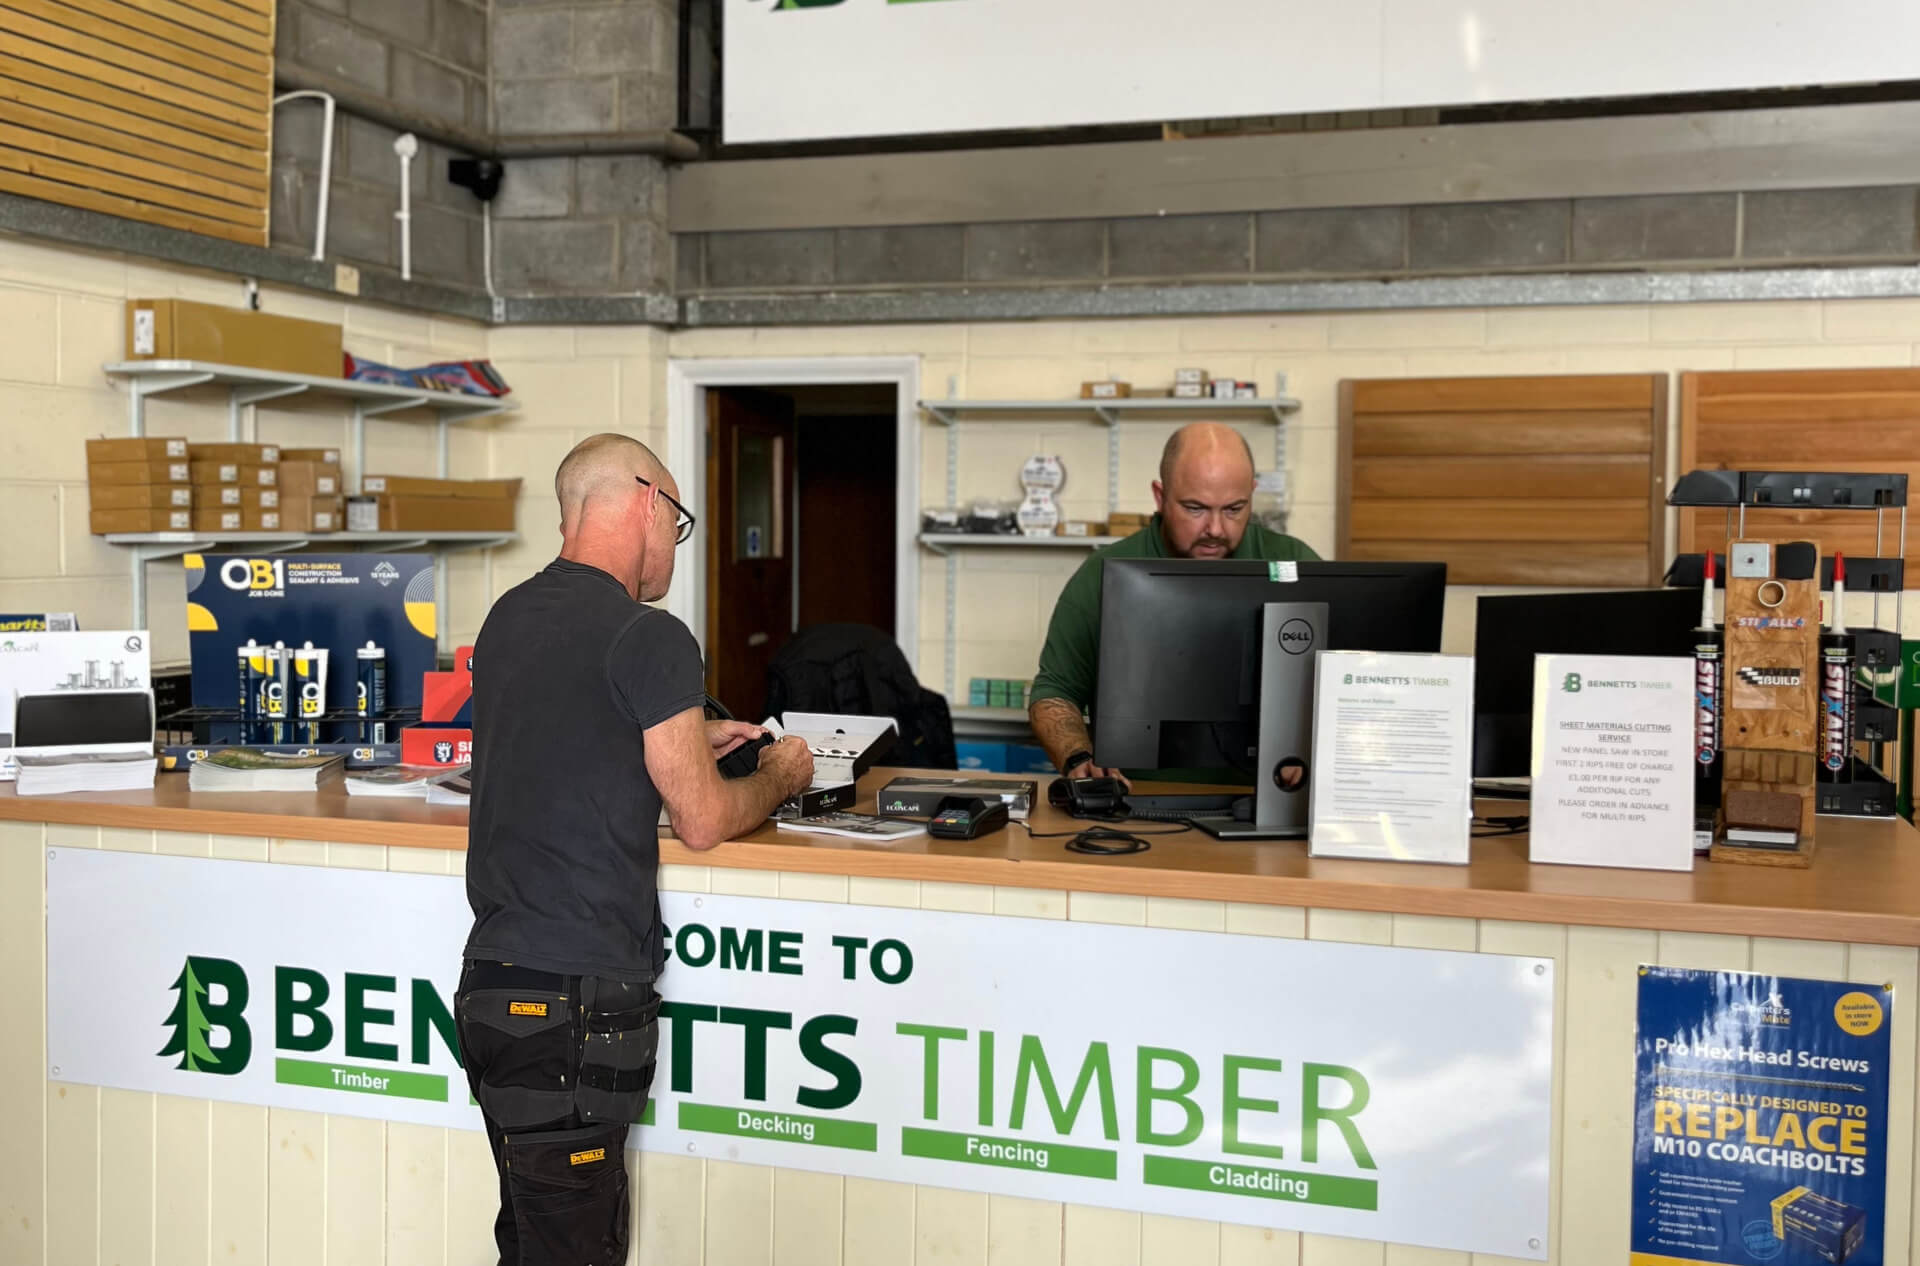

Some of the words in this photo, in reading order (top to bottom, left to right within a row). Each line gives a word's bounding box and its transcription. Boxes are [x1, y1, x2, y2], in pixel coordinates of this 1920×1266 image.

[220, 558, 285, 590] OB1
[1282, 632, 1311, 641] DELL
[1355, 676, 1410, 685] BENNETTS
[1412, 678, 1449, 686] TIMBER
[1587, 680, 1637, 688] BENNETTS
[1763, 676, 1801, 686] BUILD
[1560, 721, 1584, 730] SHEET
[1586, 722, 1632, 731] MATERIALS
[1634, 724, 1672, 733] CUTTING
[1598, 734, 1632, 743] SERVICE
[354, 748, 374, 760] OB1
[1561, 746, 1580, 754] NEW
[1583, 747, 1608, 755] PANEL
[1611, 748, 1629, 756] SAW
[1642, 749, 1669, 757] STORE
[1555, 759, 1577, 767] FIRST
[1586, 760, 1603, 769] RIPS
[1605, 761, 1624, 769] FREE
[1627, 762, 1638, 770] OF
[1640, 763, 1673, 771] CHARGE
[1593, 774, 1608, 782] PER
[1625, 776, 1641, 784] FOR
[1643, 777, 1660, 785] ANY
[1577, 786, 1627, 795] ADDITIONAL
[1629, 788, 1651, 796] CUTS
[1559, 799, 1587, 807] PLEASE
[1589, 800, 1617, 809] ORDER
[1619, 801, 1628, 809] IN
[1630, 802, 1670, 811] ADVANCE
[1582, 812, 1598, 820] FOR
[1600, 813, 1626, 821] MULTI
[1628, 814, 1646, 822] RIPS
[832, 935, 914, 985] TO
[1842, 1004, 1875, 1012] Available
[1655, 1038, 1688, 1057] Pro
[1694, 1041, 1734, 1062] Hex
[1739, 1046, 1791, 1067] Head
[1797, 1051, 1869, 1073] Screws
[331, 1068, 390, 1091] Timber
[896, 1022, 1379, 1170] TIMBER
[1655, 1086, 1756, 1107] SPECIFICALLY
[1761, 1095, 1842, 1116] DESIGNED
[1845, 1104, 1868, 1118] TO
[738, 1112, 815, 1140] Decking
[1654, 1100, 1867, 1156] REPLACE
[966, 1137, 1049, 1168] Fencing
[1654, 1136, 1700, 1158] M10
[1706, 1142, 1865, 1176] COACHBOLTS
[1208, 1166, 1310, 1199] Cladding
